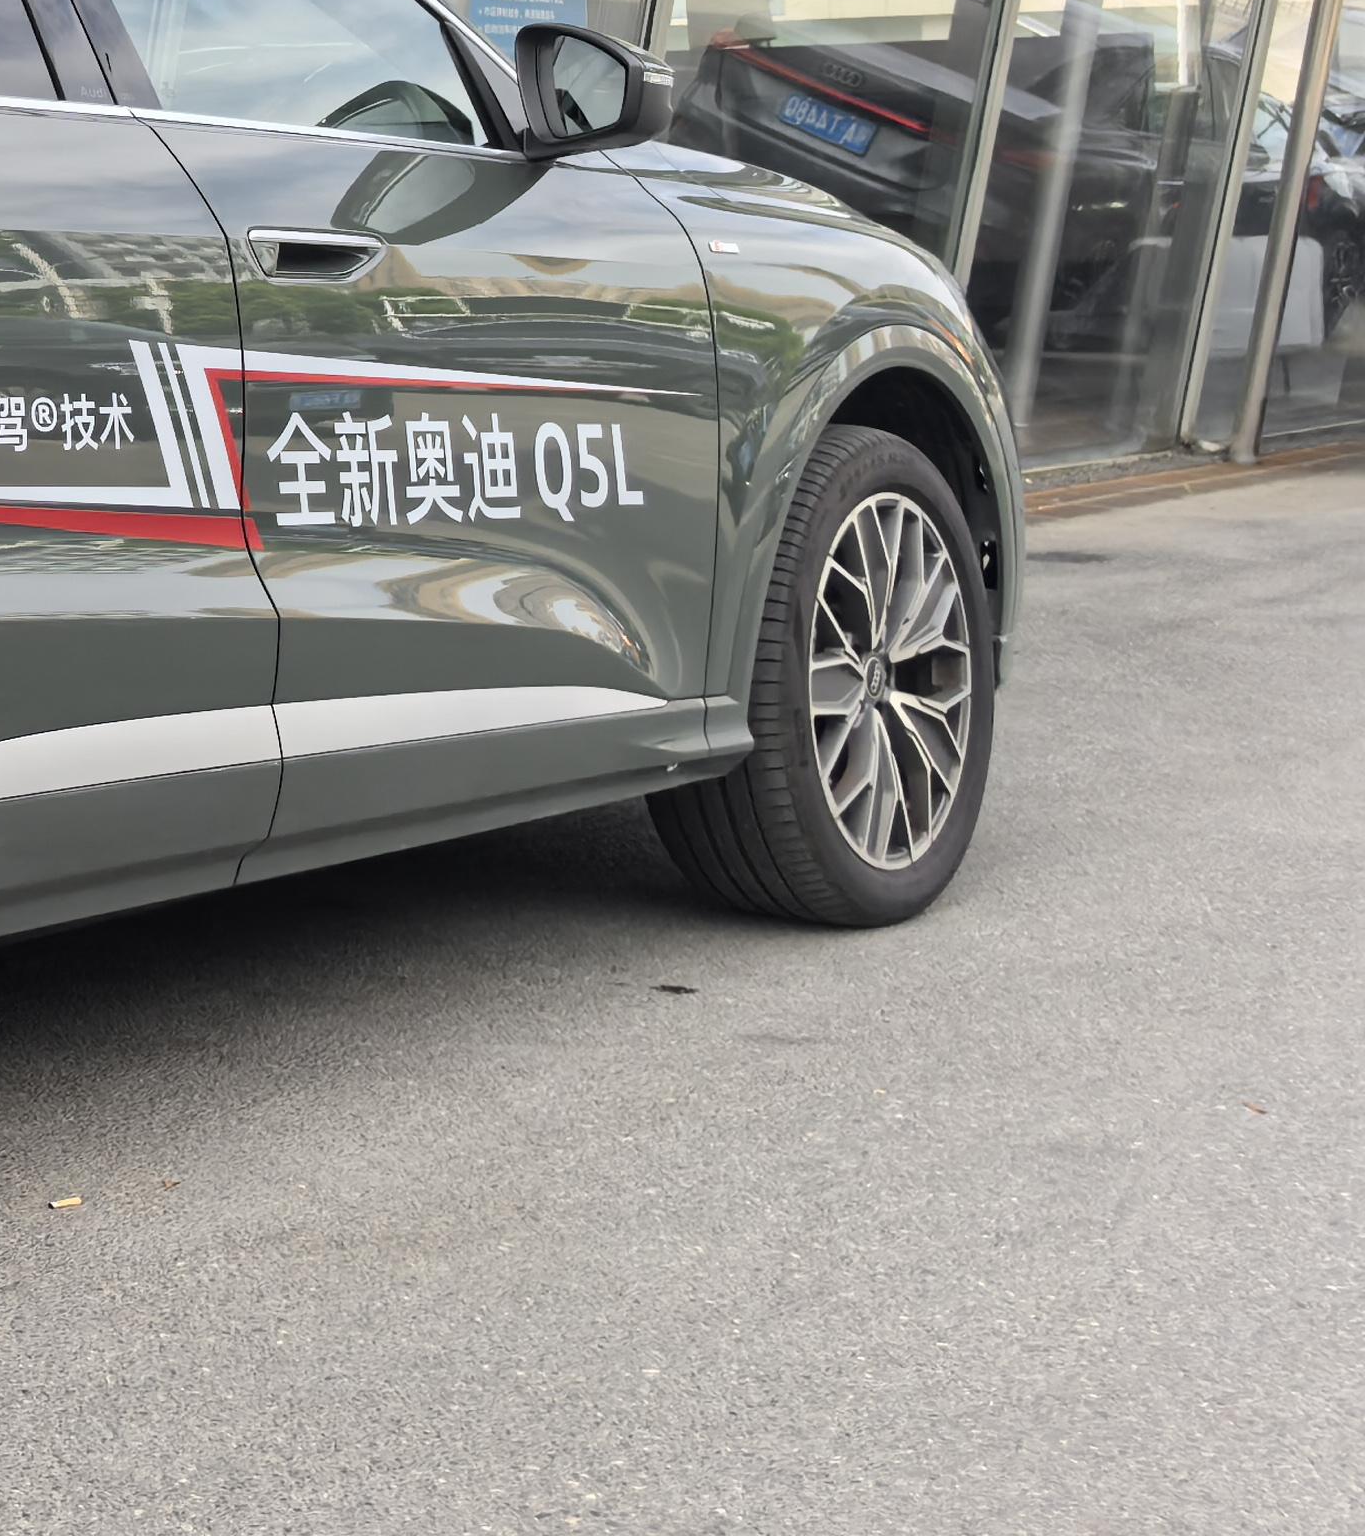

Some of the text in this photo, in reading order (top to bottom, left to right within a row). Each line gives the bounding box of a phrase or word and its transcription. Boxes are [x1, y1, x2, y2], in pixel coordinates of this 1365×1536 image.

[265, 409, 644, 529] 全新奥迪 Q5L
